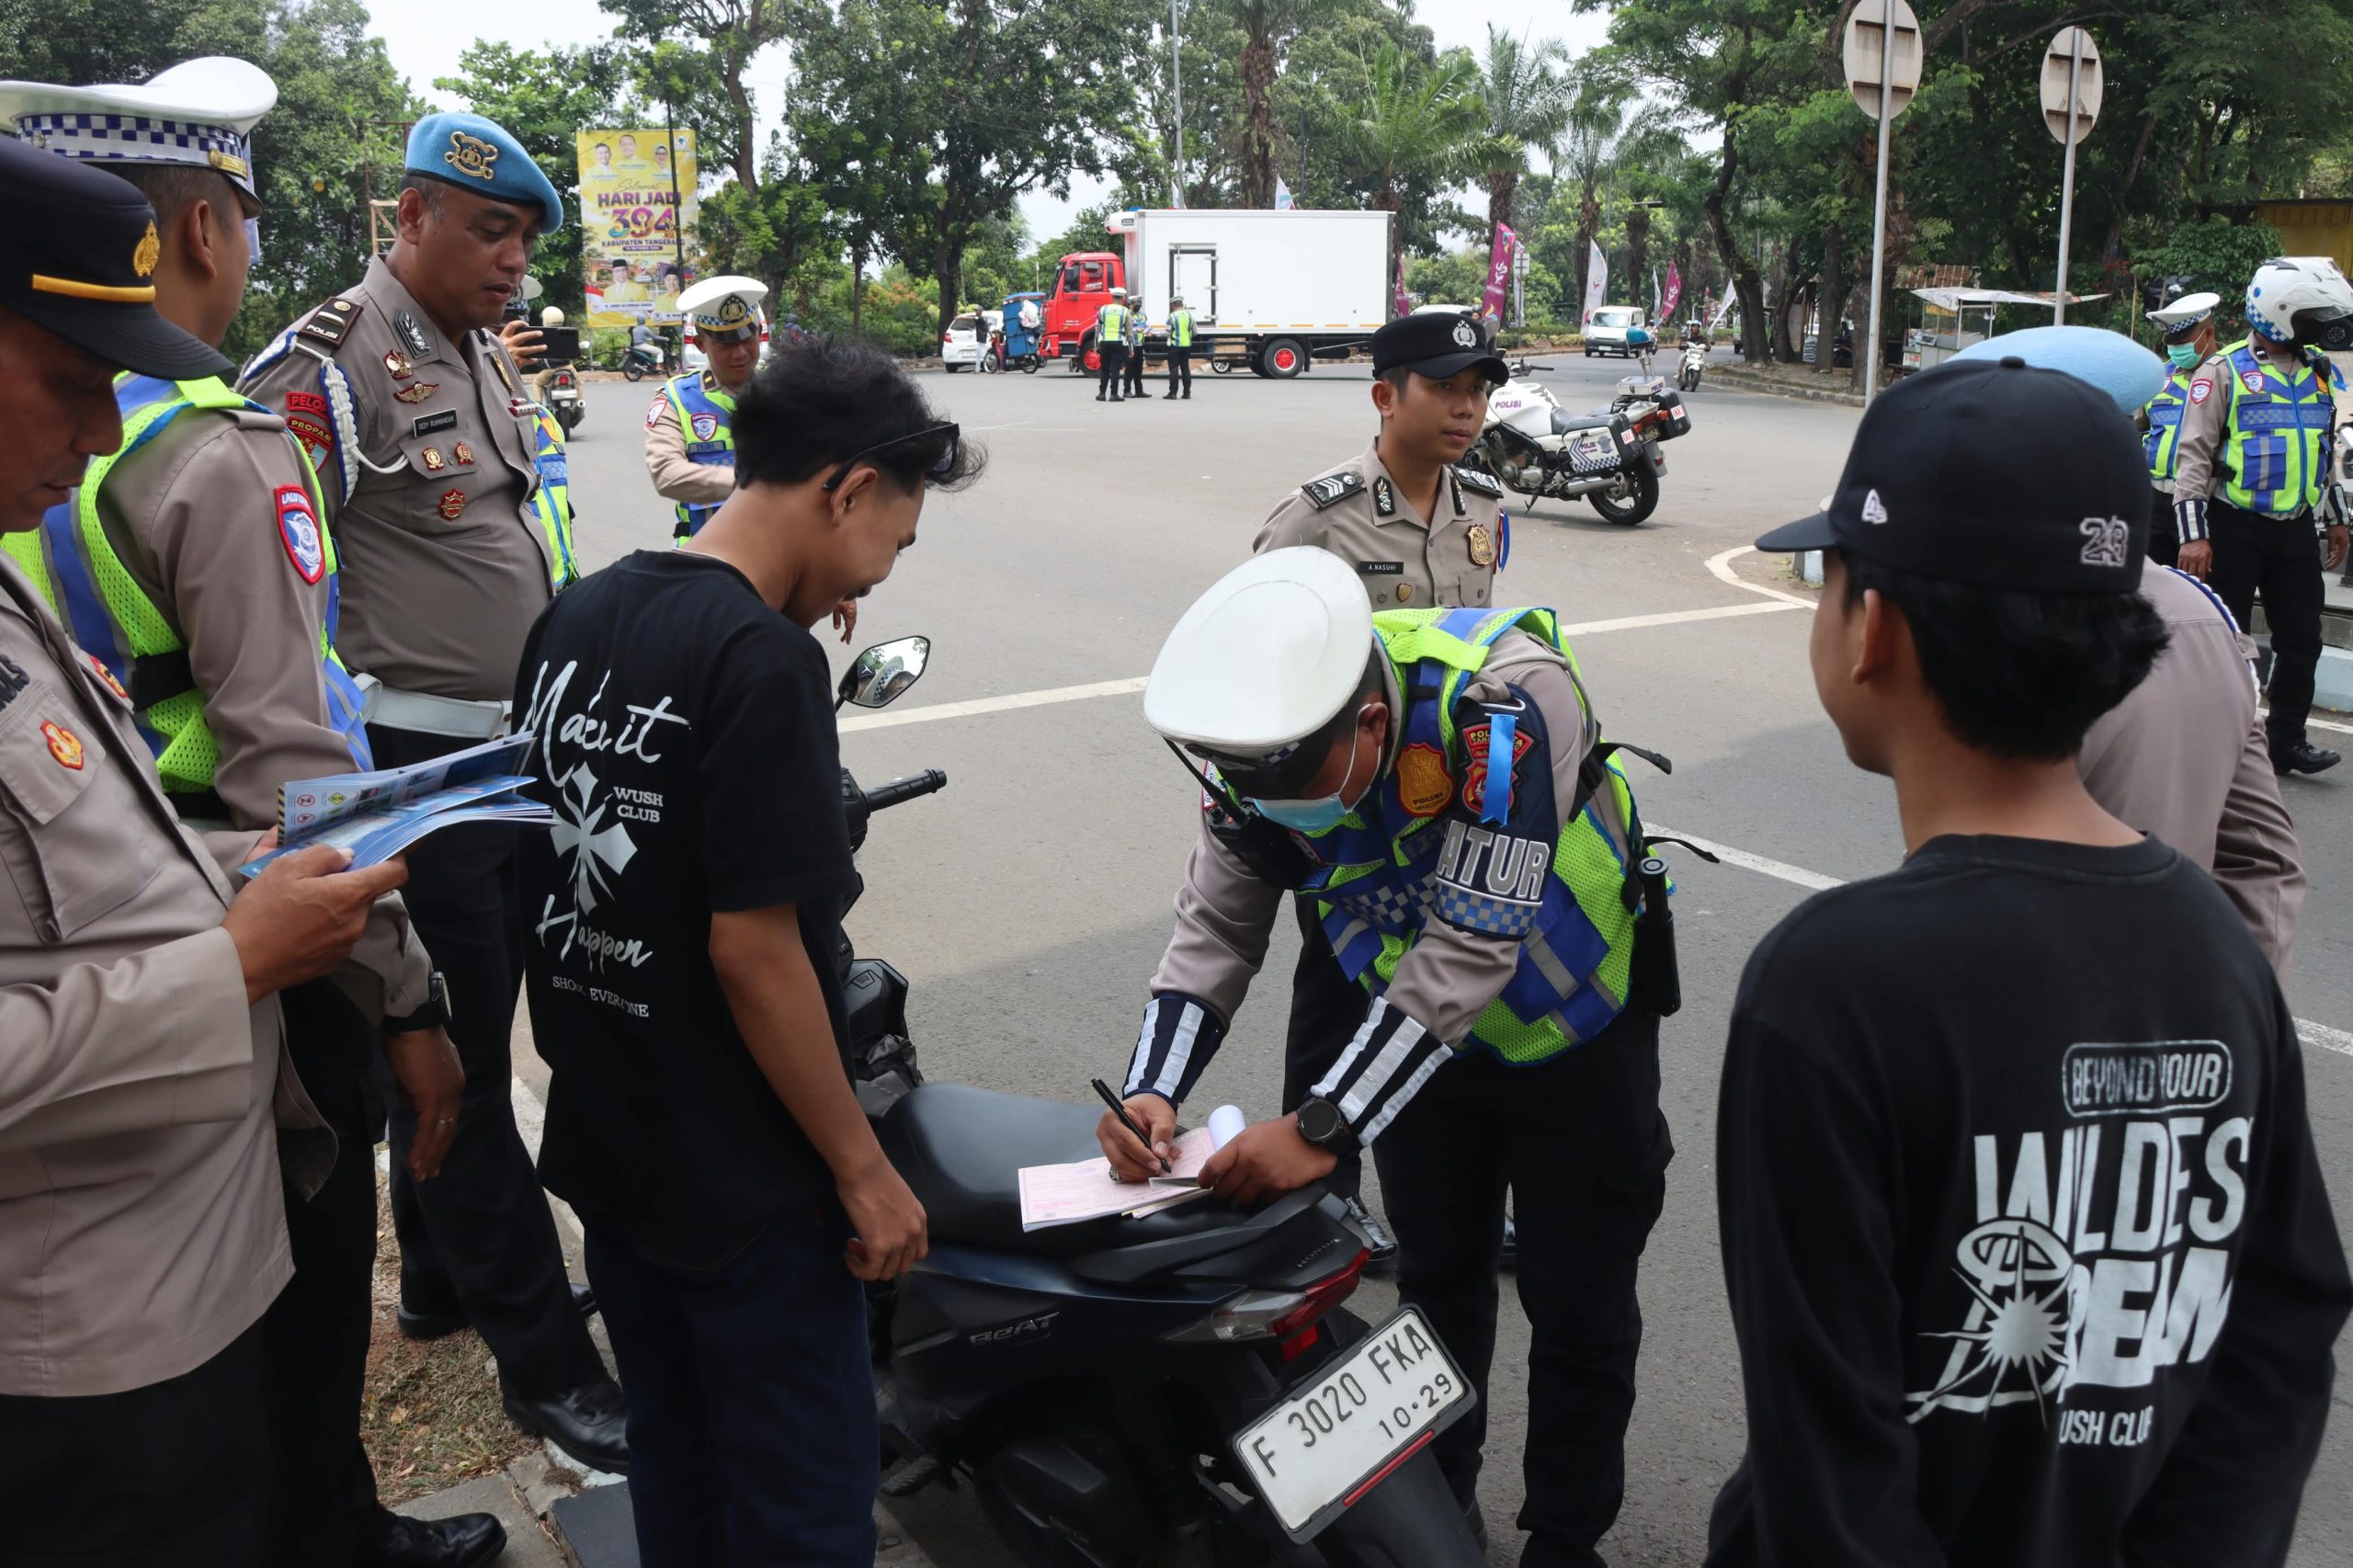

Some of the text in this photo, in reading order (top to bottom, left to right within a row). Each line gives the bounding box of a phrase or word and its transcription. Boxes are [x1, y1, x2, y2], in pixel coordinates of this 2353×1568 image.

[597, 191, 682, 207] HARI JADI
[608, 207, 678, 238] 394
[602, 239, 642, 247] KABUPATEN
[306, 324, 339, 339] POLISI
[1495, 400, 1522, 409] POLISI
[291, 419, 332, 442] PROPAM
[1374, 563, 1397, 572] NASUHI
[613, 787, 664, 807] WUSH
[617, 804, 661, 823] CLUB
[535, 882, 654, 975] Happen
[2072, 1055, 2156, 1107] BEYOND
[1252, 1324, 1433, 1478] F 3020 FKA
